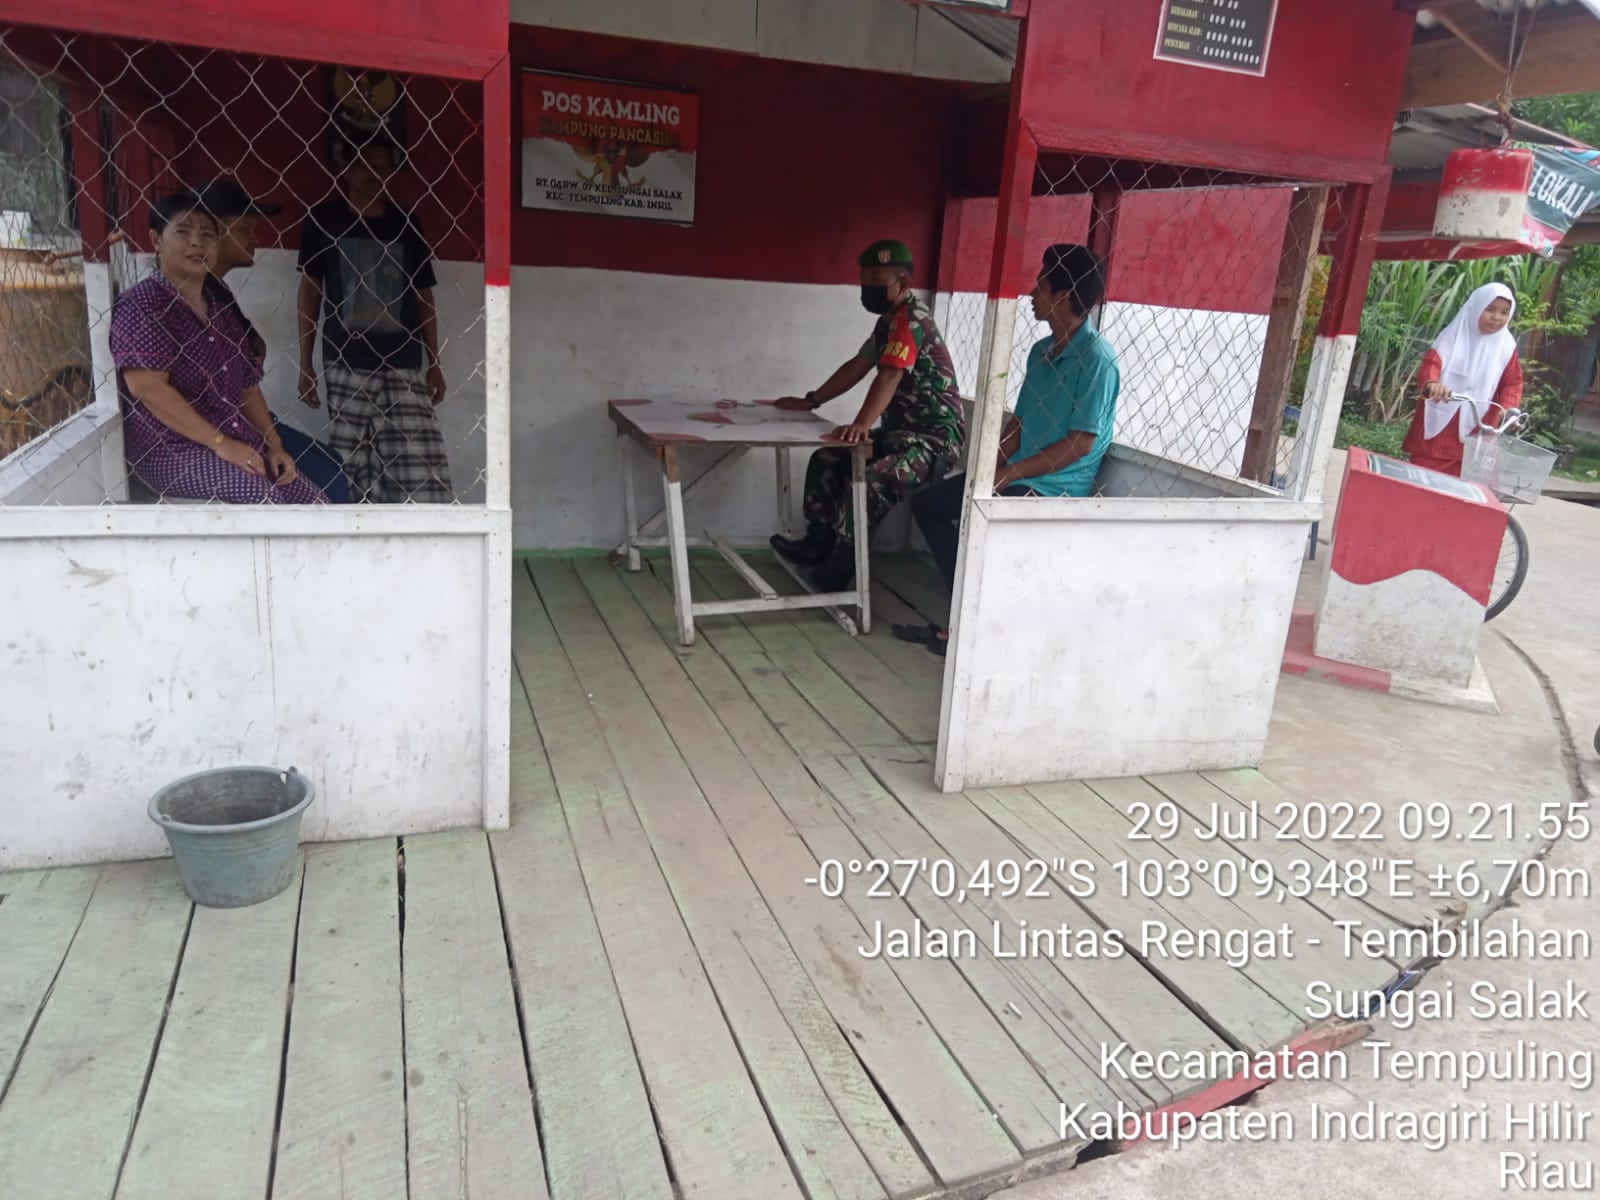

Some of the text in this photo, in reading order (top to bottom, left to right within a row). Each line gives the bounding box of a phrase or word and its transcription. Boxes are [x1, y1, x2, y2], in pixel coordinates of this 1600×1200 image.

[541, 90, 680, 126] POS KAMLING
[541, 117, 606, 138] MPUNG
